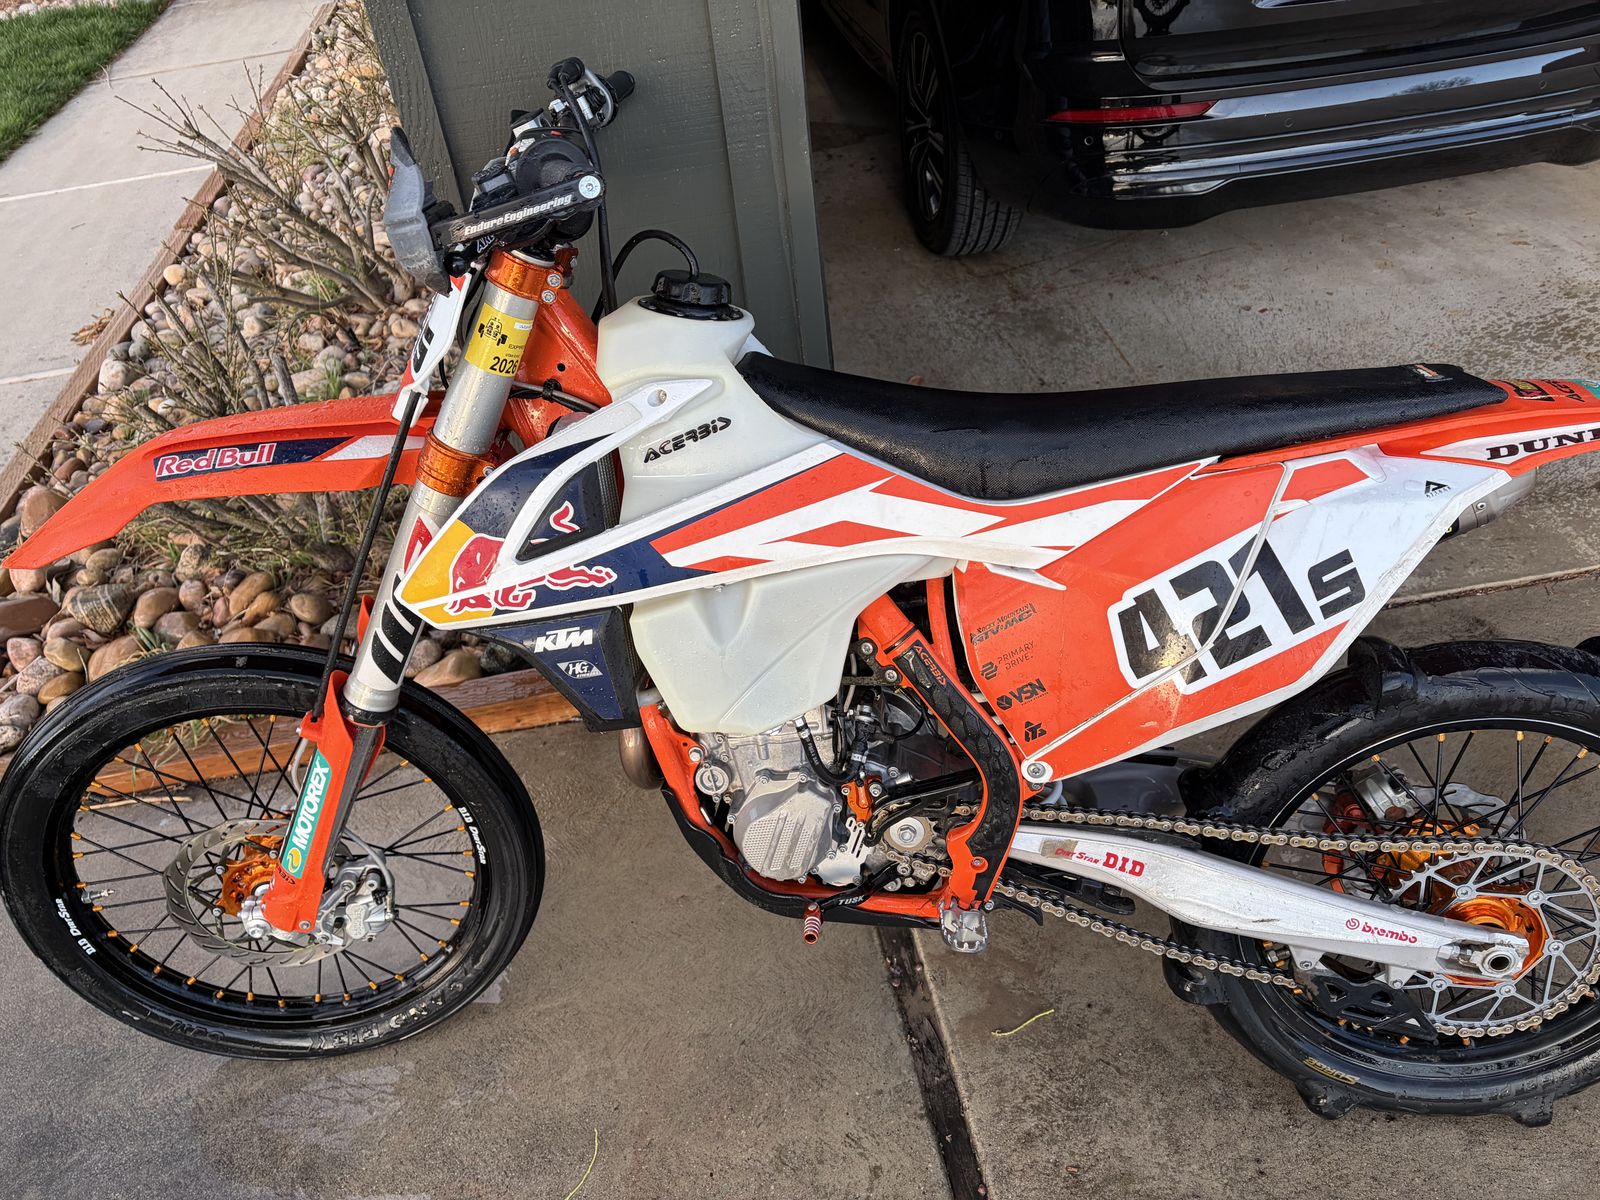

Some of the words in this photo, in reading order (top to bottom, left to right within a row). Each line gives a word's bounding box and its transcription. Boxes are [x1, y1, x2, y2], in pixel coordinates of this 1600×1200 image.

[504, 194, 573, 222] Engineering
[155, 448, 218, 478] Red
[215, 442, 277, 469] Bull
[533, 626, 593, 653] KTM
[997, 640, 1035, 665] PRIMARY
[1009, 678, 1046, 703] VSN
[291, 756, 329, 851] MOTOREX
[838, 894, 865, 906] TUSK
[1361, 921, 1418, 944] brembo
